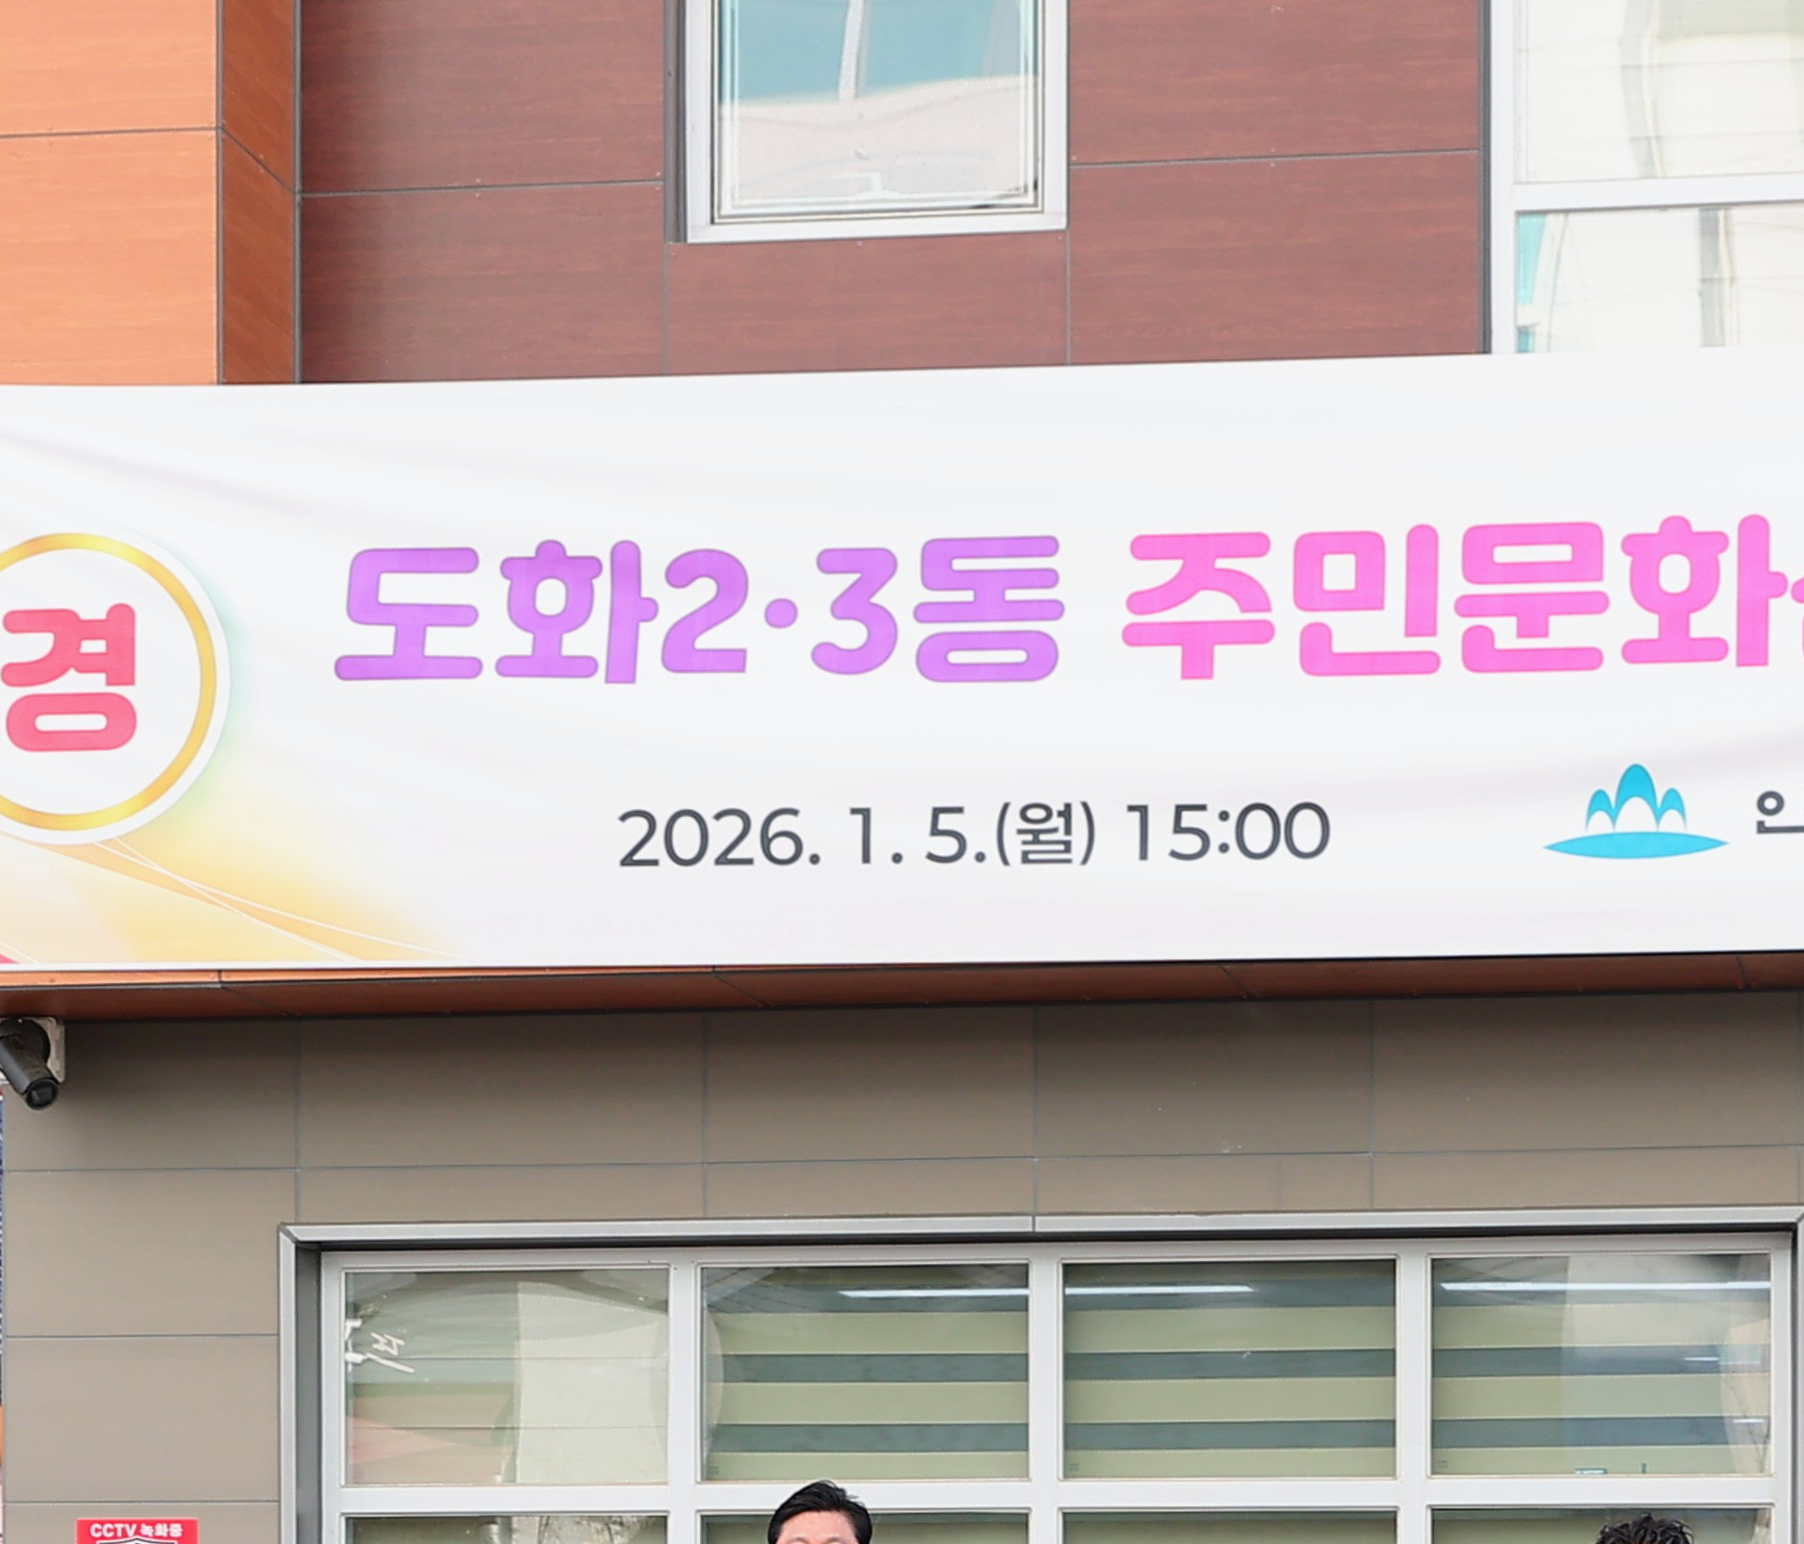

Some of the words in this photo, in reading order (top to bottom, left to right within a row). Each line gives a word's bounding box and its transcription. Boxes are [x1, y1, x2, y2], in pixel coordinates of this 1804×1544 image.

[335, 535, 1065, 684] 도화2·3동
[0, 601, 138, 754] 경
[617, 805, 822, 868] 2026.
[1126, 800, 1332, 862] 15:00
[90, 1522, 137, 1538] CCTV
[140, 1522, 183, 1538] 녹화중
